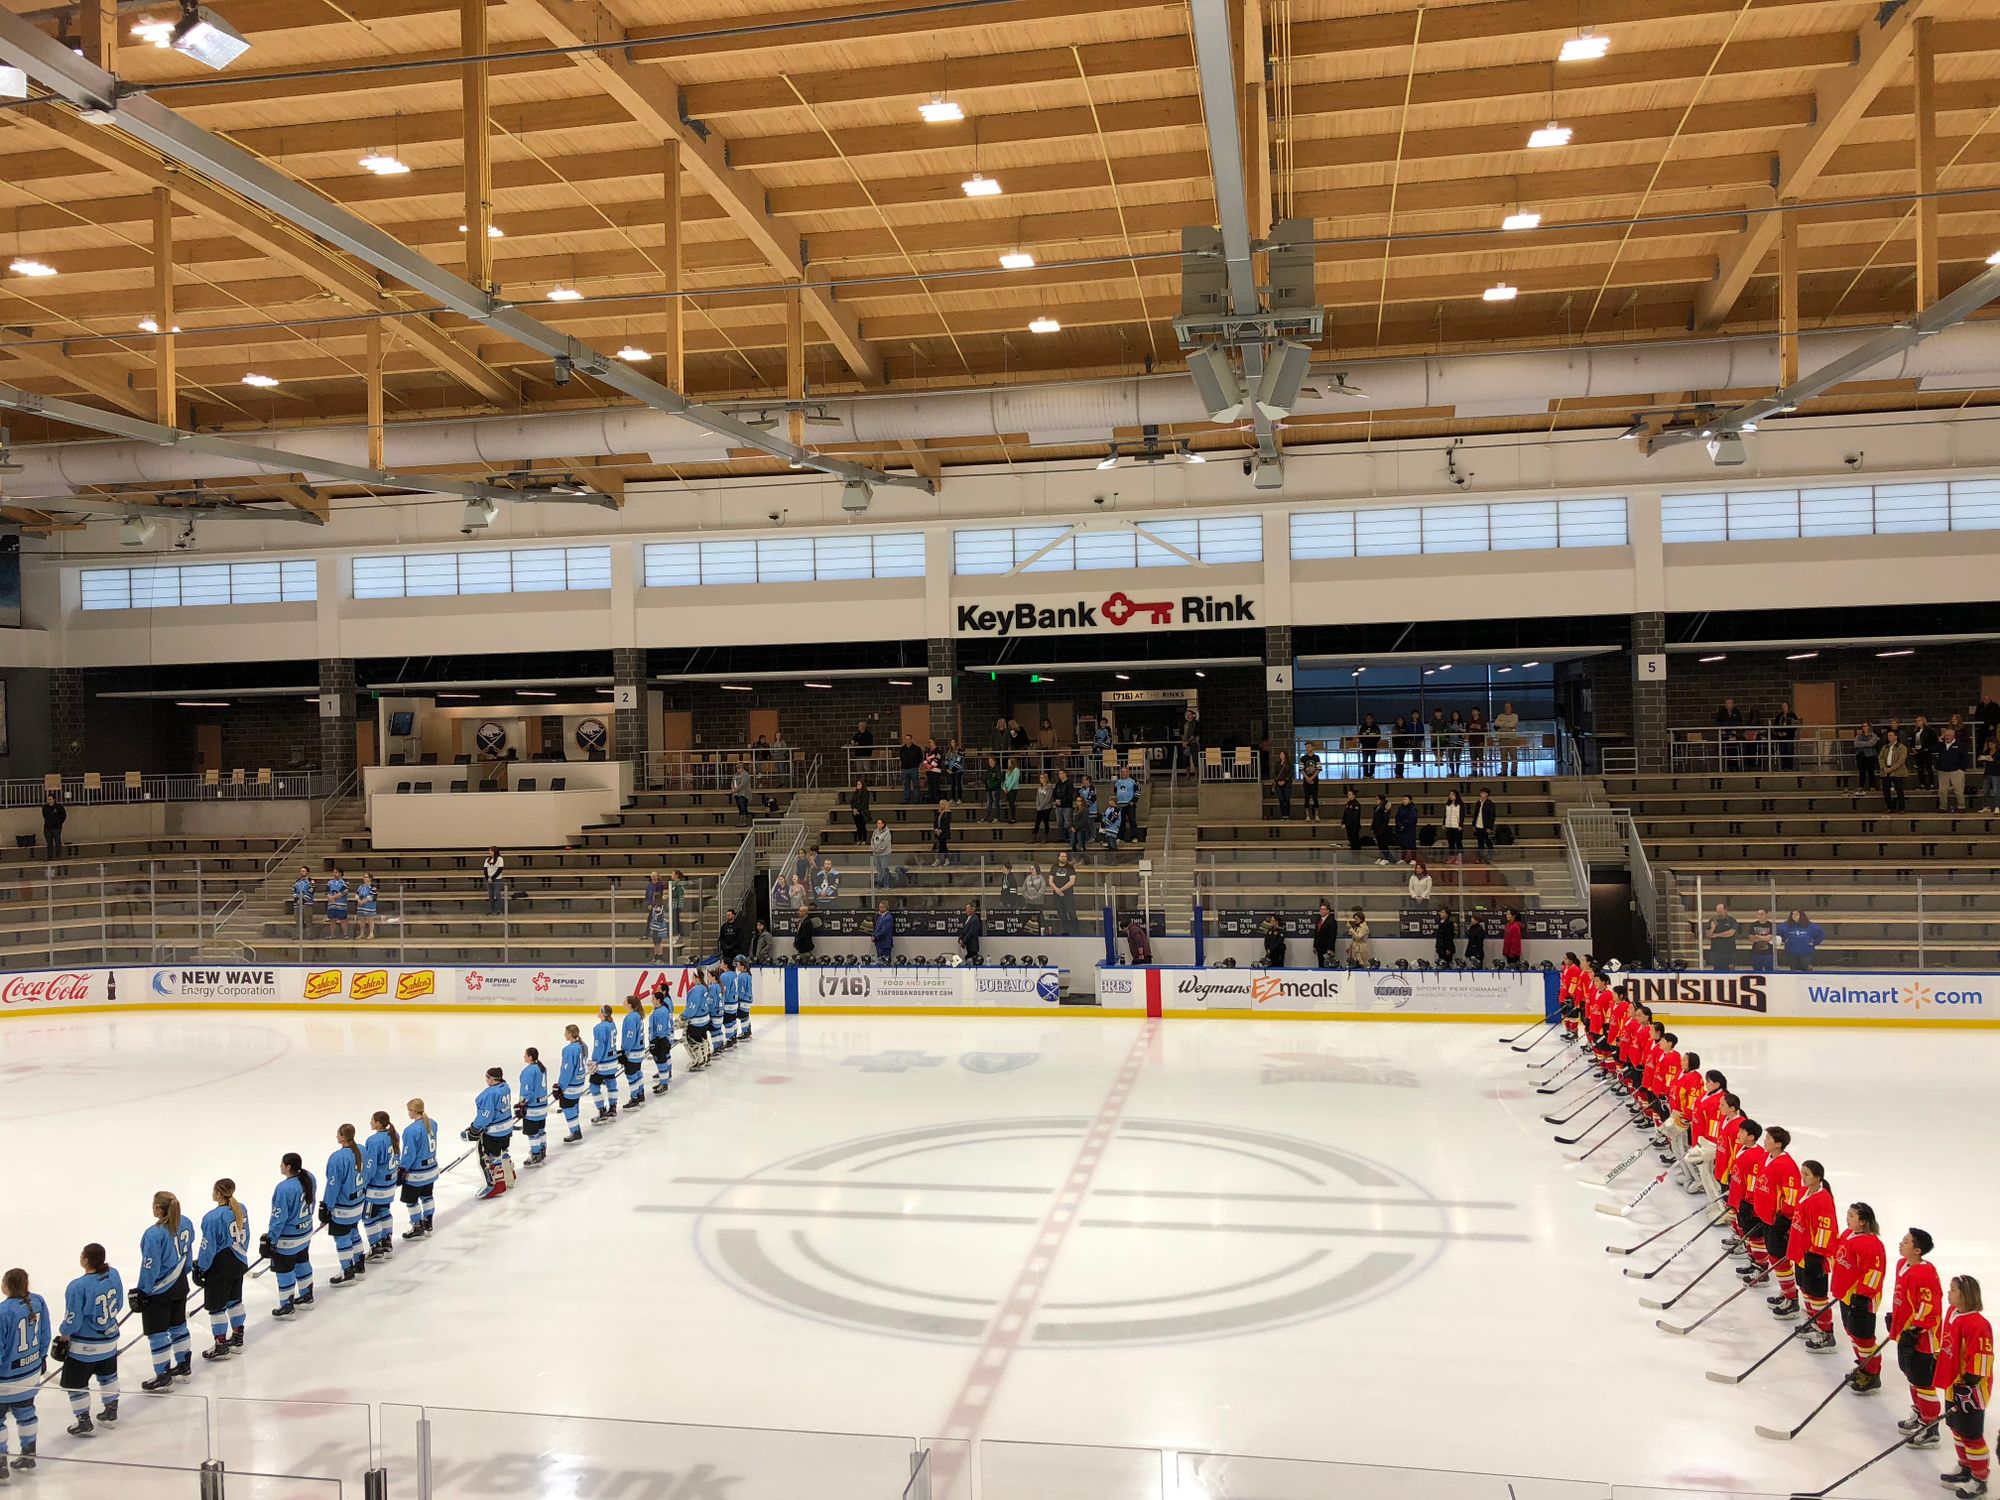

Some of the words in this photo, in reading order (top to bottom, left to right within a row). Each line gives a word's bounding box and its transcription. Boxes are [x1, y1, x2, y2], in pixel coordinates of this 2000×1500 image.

[958, 602, 1098, 635] KeyBank
[1182, 594, 1256, 624] Rink
[1648, 661, 1656, 673] 5
[1275, 672, 1284, 683] 4
[936, 683, 944, 694] 3
[622, 692, 629, 702] 2
[1113, 691, 1133, 701] (716)
[327, 701, 332, 710] 1
[181, 971, 223, 985] NEW
[225, 971, 274, 985] WAVE
[181, 985, 215, 998] Energy
[217, 985, 275, 997] Corporation
[818, 975, 871, 998] (716)
[976, 978, 1035, 993] BUFFALO
[1178, 975, 1250, 1001] Wegmans
[1808, 986, 1899, 1004] Walmart
[1934, 991, 1983, 1005] com
[1669, 1065, 1677, 1074] 13
[1788, 1176, 1794, 1187] 6
[95, 1288, 118, 1325] 32
[18, 1313, 40, 1353] 17
[1978, 1337, 1992, 1351] 15
